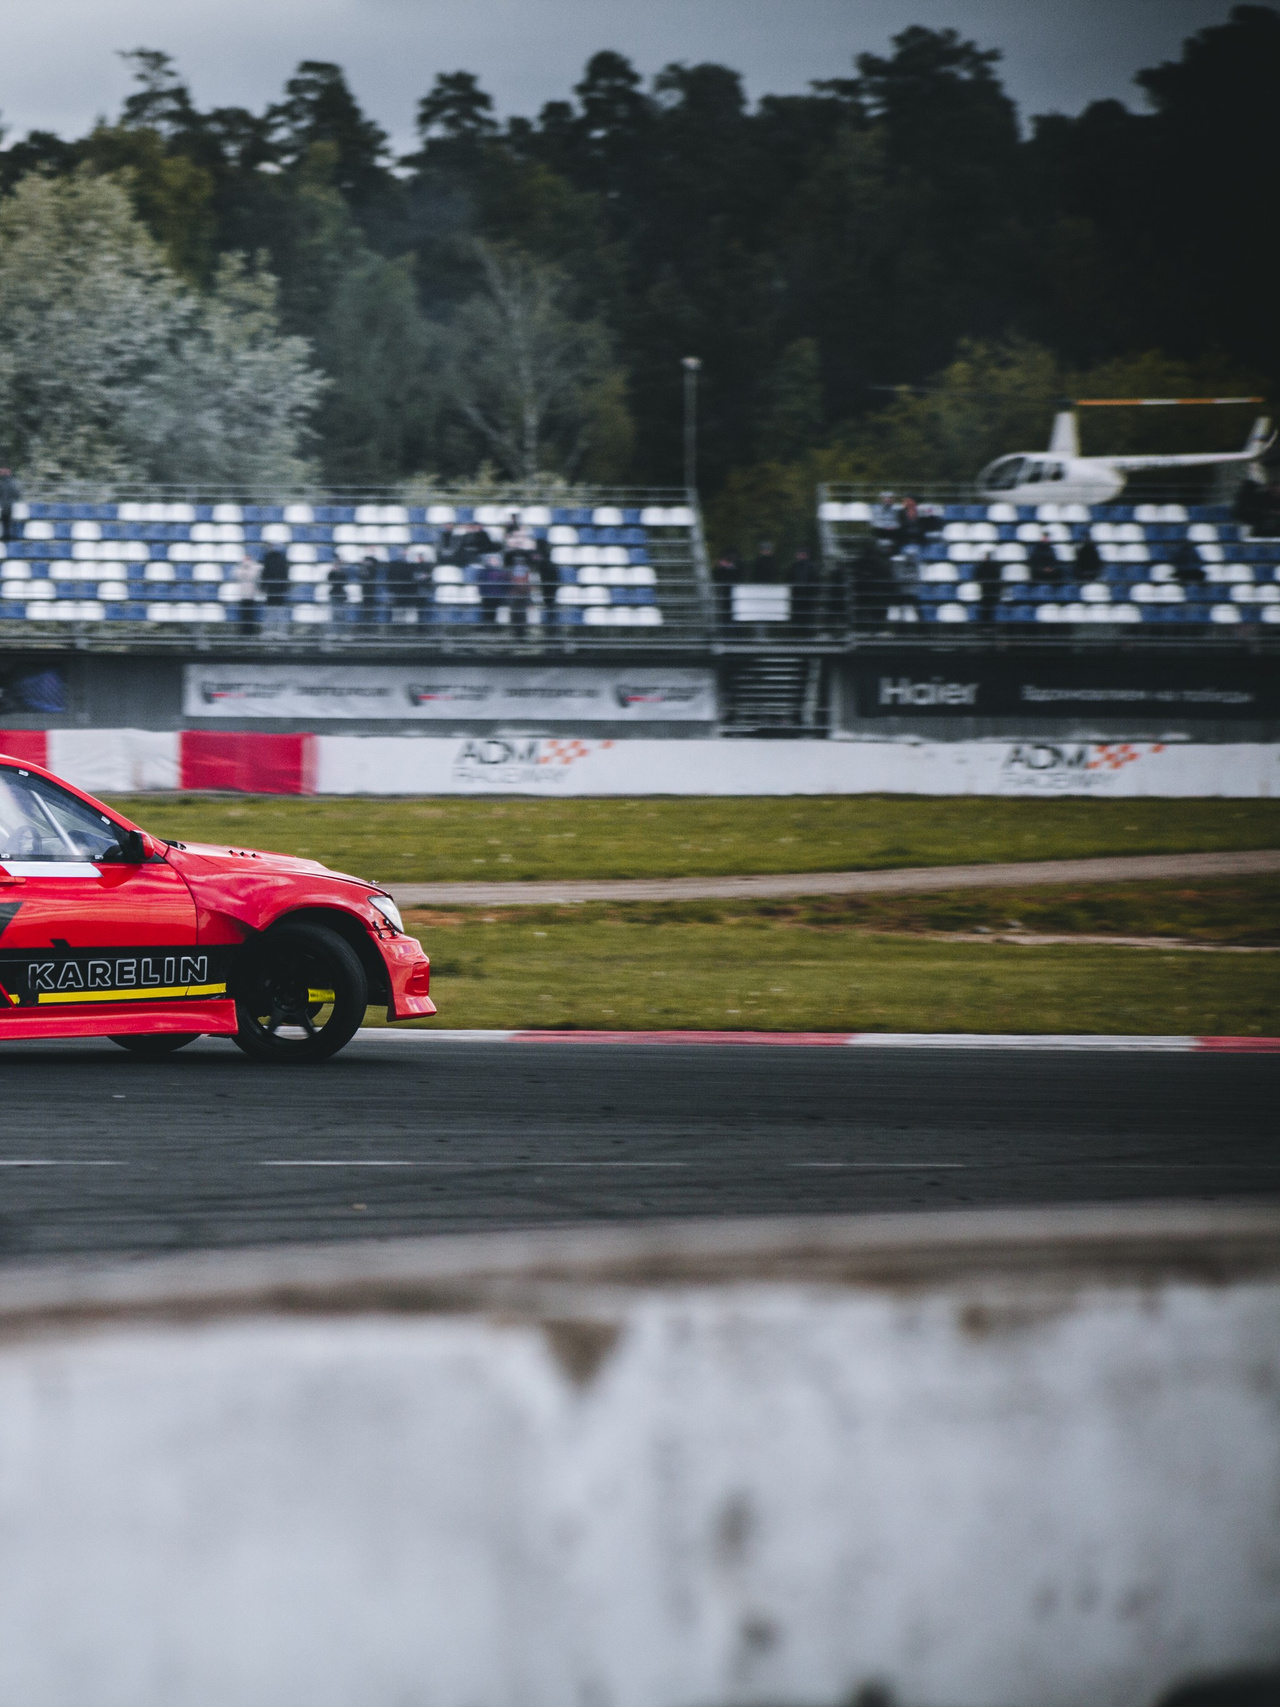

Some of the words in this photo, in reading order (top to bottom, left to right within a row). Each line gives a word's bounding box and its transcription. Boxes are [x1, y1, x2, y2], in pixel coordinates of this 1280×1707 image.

[879, 677, 979, 705] Haier
[455, 740, 540, 764] ADM
[28, 955, 208, 990] KARELIN
